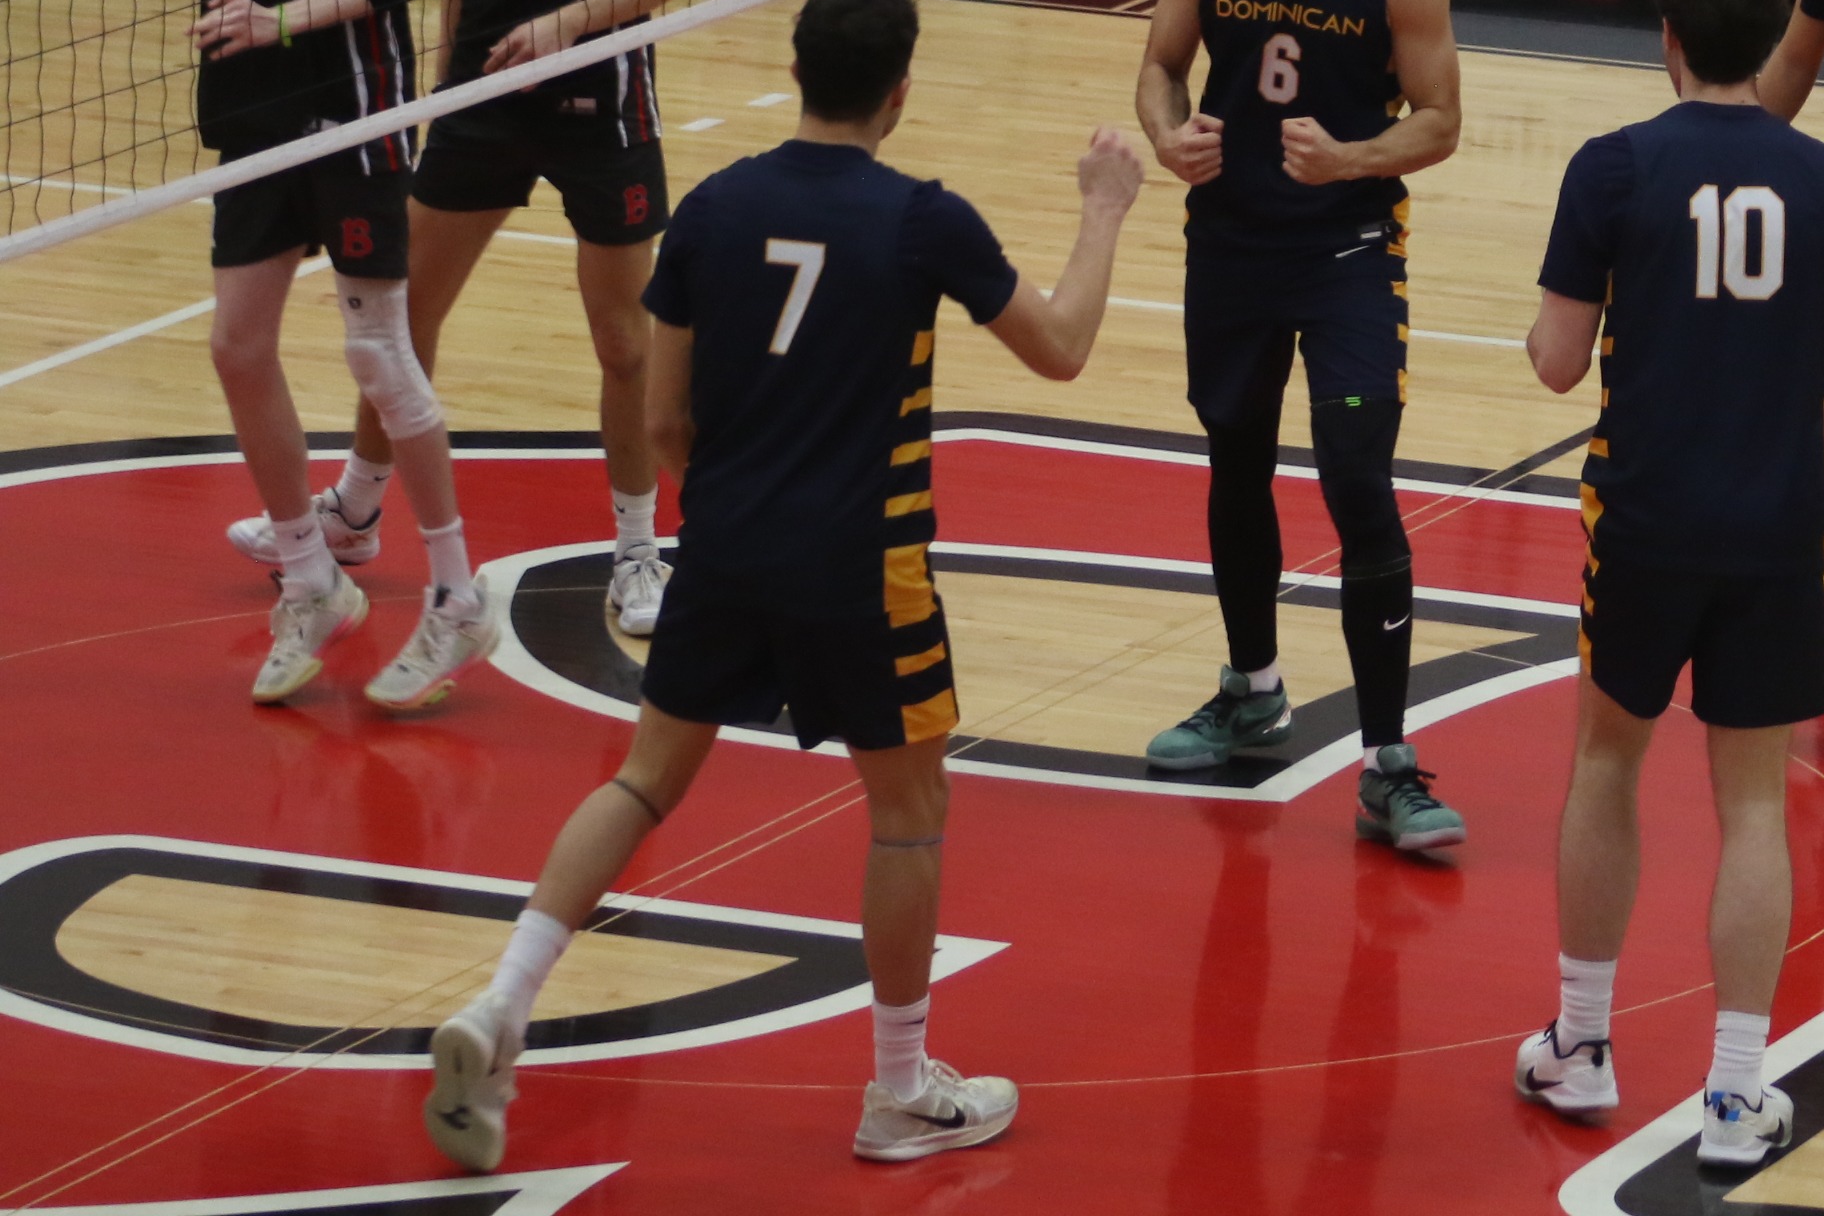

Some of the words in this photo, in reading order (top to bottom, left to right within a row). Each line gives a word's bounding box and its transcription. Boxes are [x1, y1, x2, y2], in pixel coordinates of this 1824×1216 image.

[1257, 34, 1299, 104] 6
[341, 217, 374, 259] B
[624, 184, 649, 225] B
[1688, 184, 1785, 301] 10
[764, 238, 827, 356] 7
